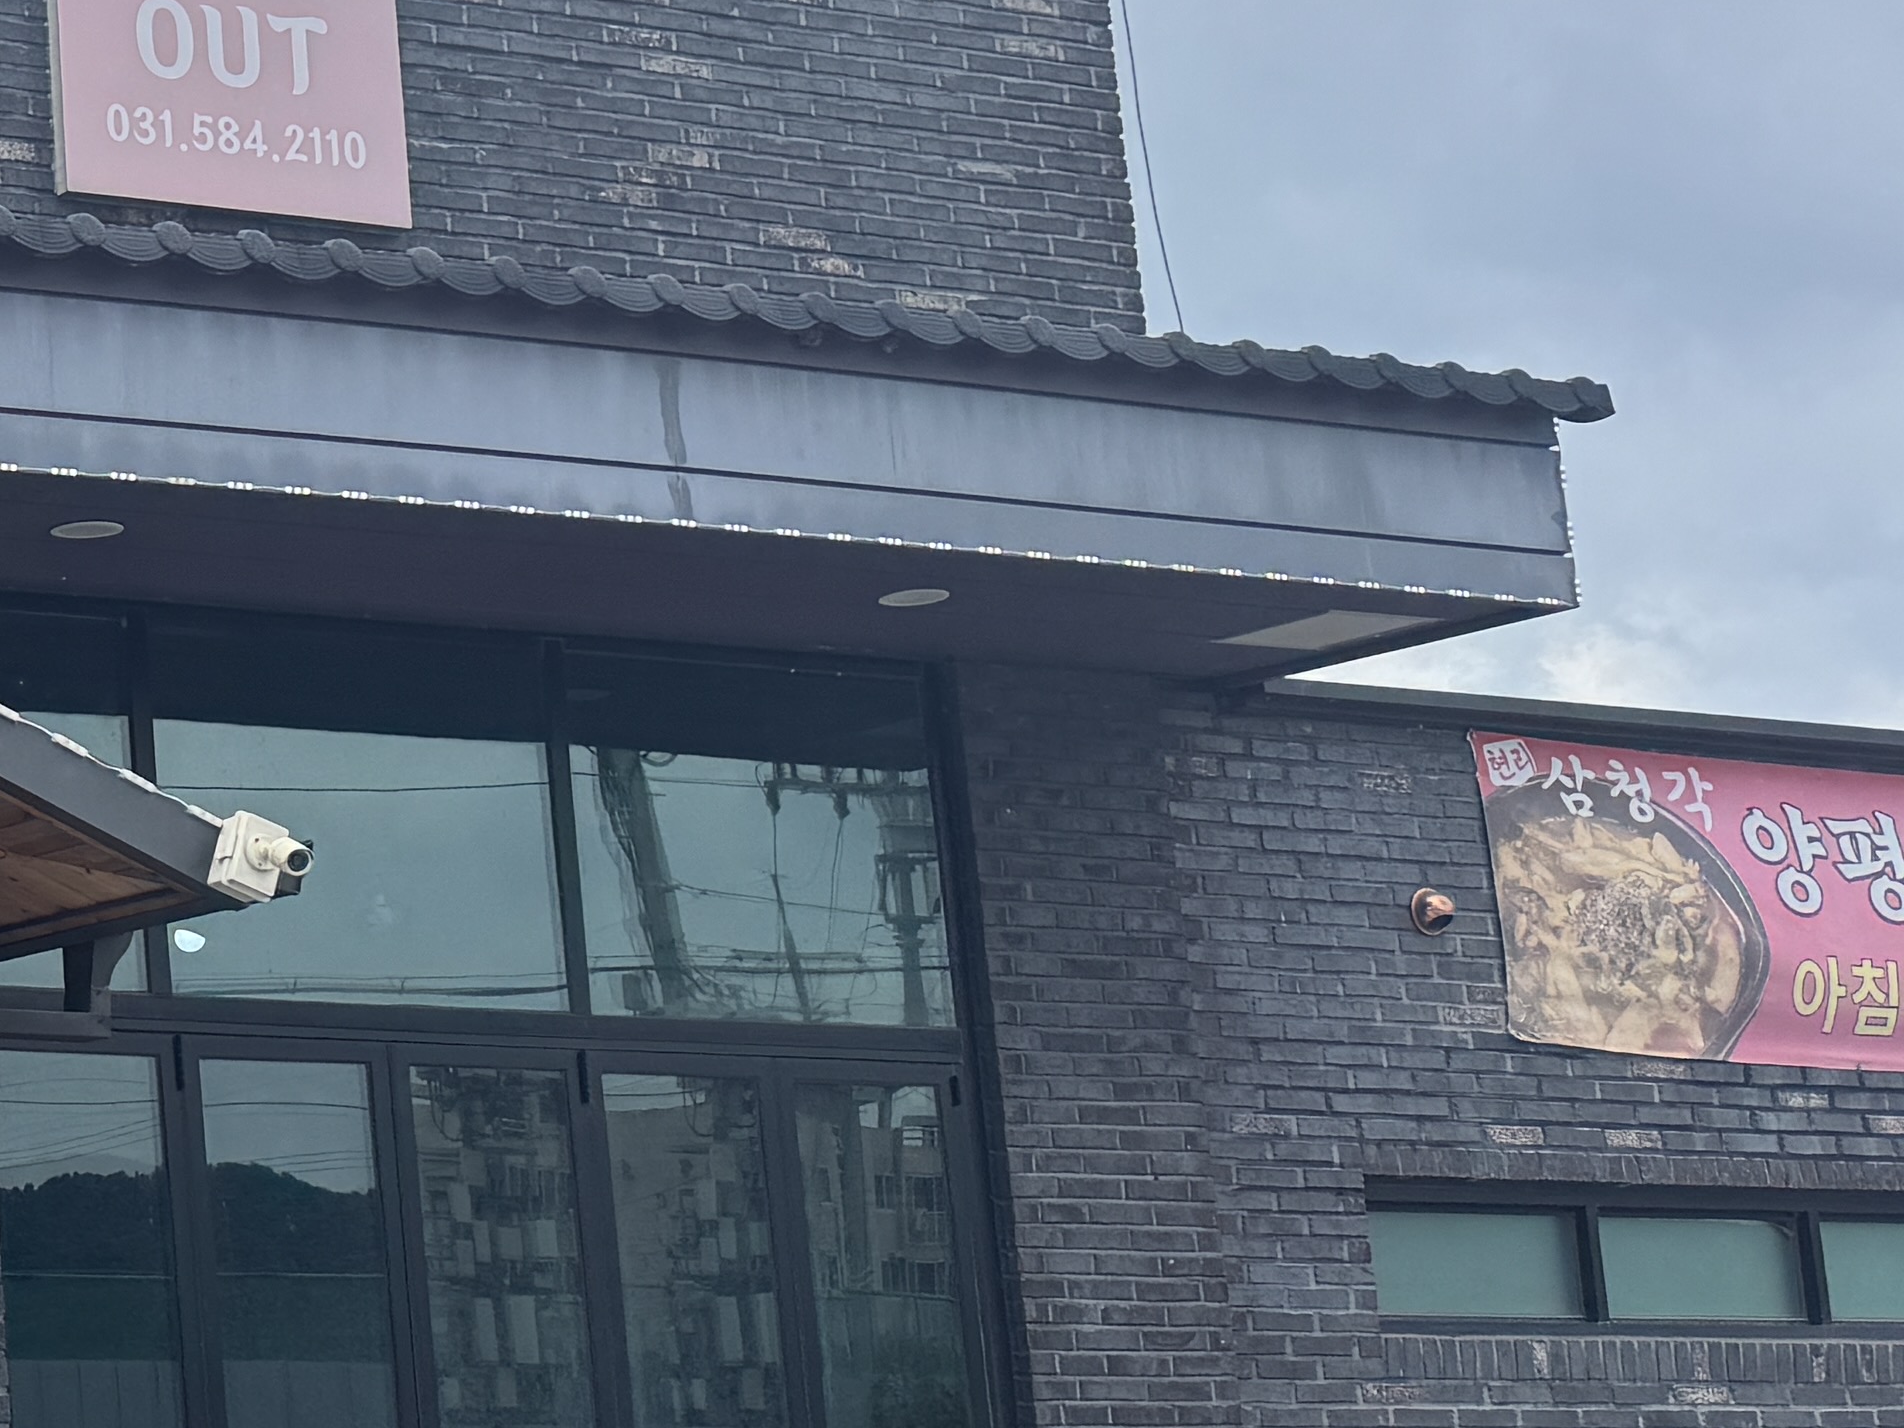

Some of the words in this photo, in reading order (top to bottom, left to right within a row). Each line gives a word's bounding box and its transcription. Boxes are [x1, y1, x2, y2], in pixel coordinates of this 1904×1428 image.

[106, 103, 367, 169] 031.584.2110
[1488, 744, 1535, 782] 현리
[1541, 755, 1713, 832] 삼청각
[1741, 802, 1904, 924] 양평
[1793, 956, 1899, 1036] 아침
